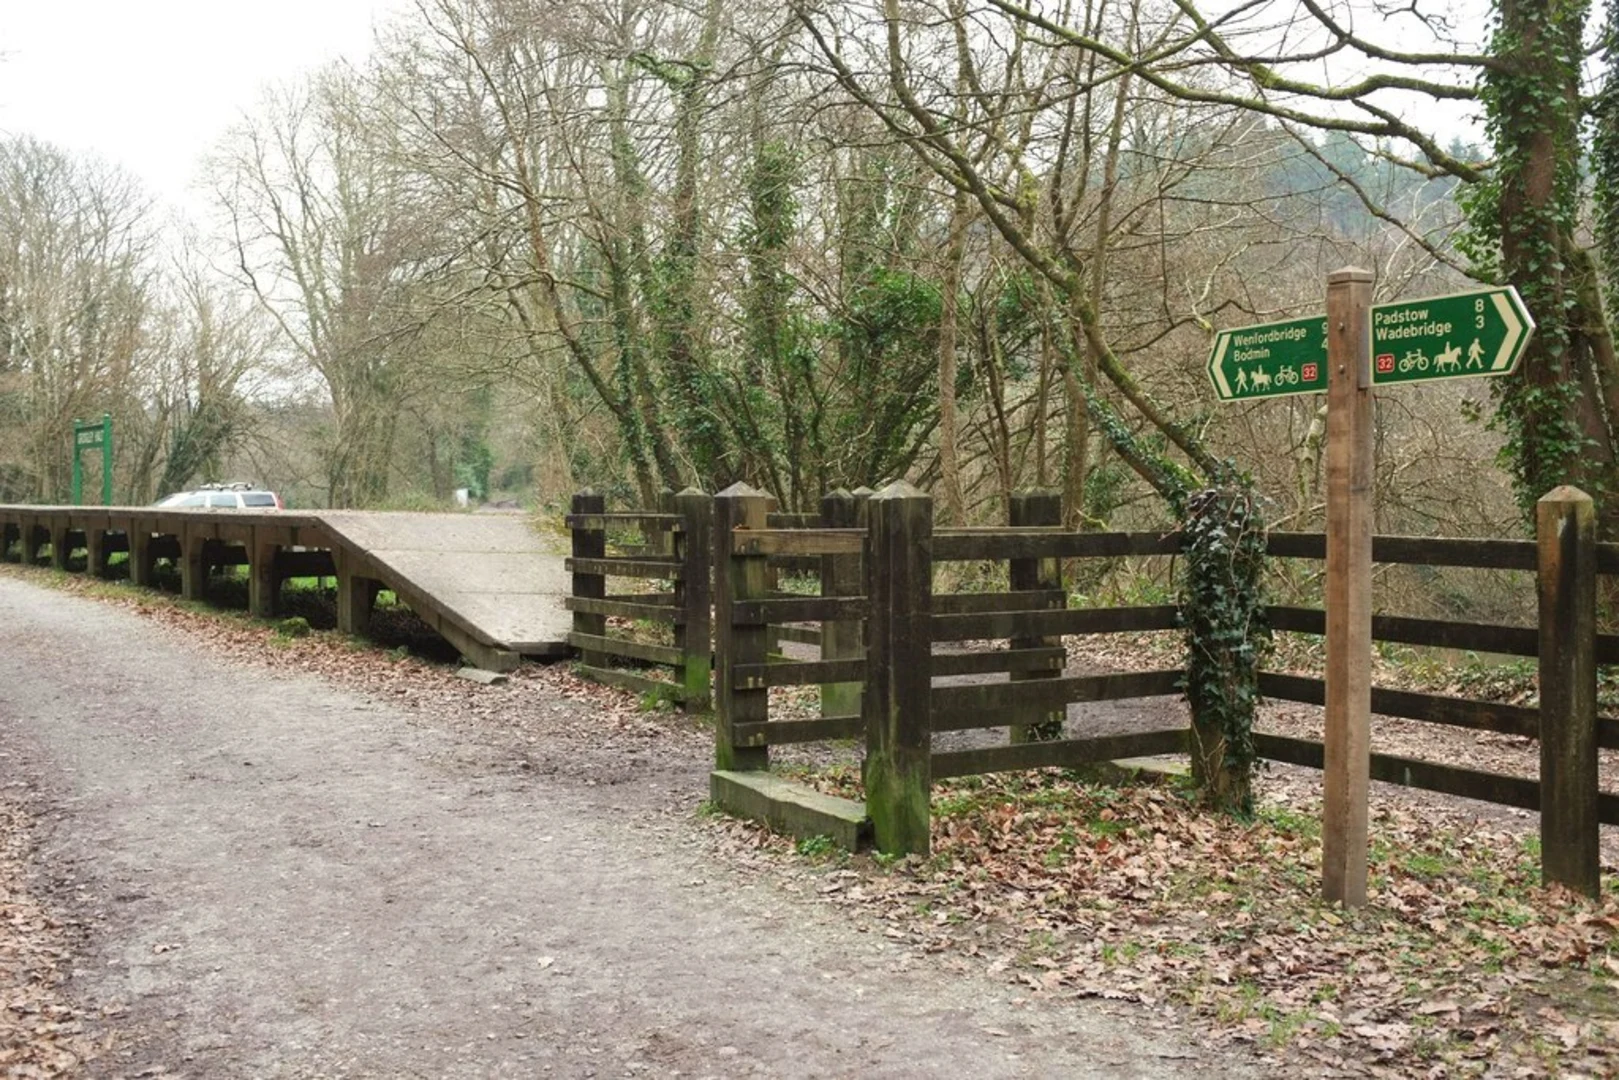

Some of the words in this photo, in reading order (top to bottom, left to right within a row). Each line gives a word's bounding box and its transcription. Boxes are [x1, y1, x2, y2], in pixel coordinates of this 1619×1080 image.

[1375, 309, 1428, 325] Padstow
[1475, 299, 1484, 312] 8
[1376, 322, 1452, 340] Wadebridge
[1475, 315, 1484, 328] 3
[1233, 327, 1306, 347] Wenfordbridge
[1234, 347, 1270, 362] Bodmin
[1378, 357, 1393, 369] 32
[1304, 367, 1316, 378] 32
